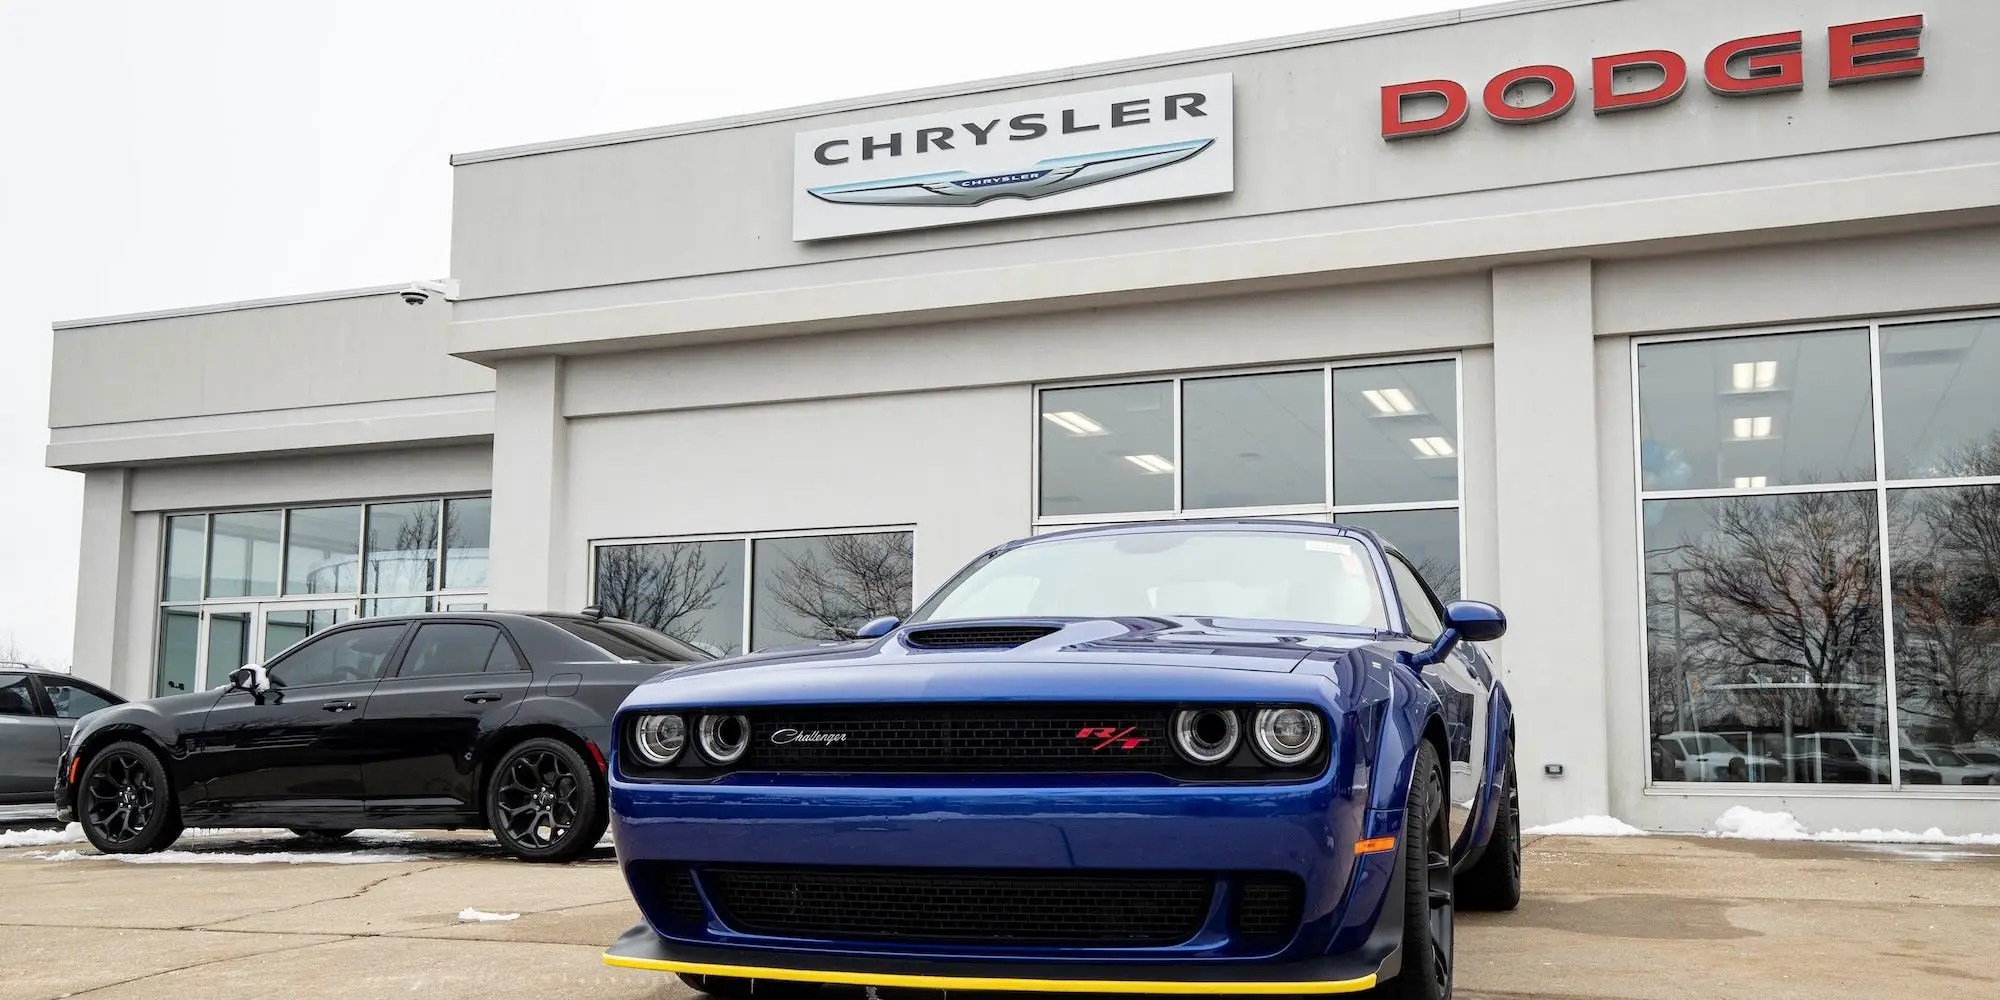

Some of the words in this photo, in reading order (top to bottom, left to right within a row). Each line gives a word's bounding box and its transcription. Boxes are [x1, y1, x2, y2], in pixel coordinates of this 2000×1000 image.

[1381, 14, 1925, 141] DODGE
[813, 92, 1208, 166] CHRYSLER
[961, 173, 1039, 187] CHRYSLER
[771, 728, 847, 746] Challenger
[1076, 726, 1150, 751] R/T
